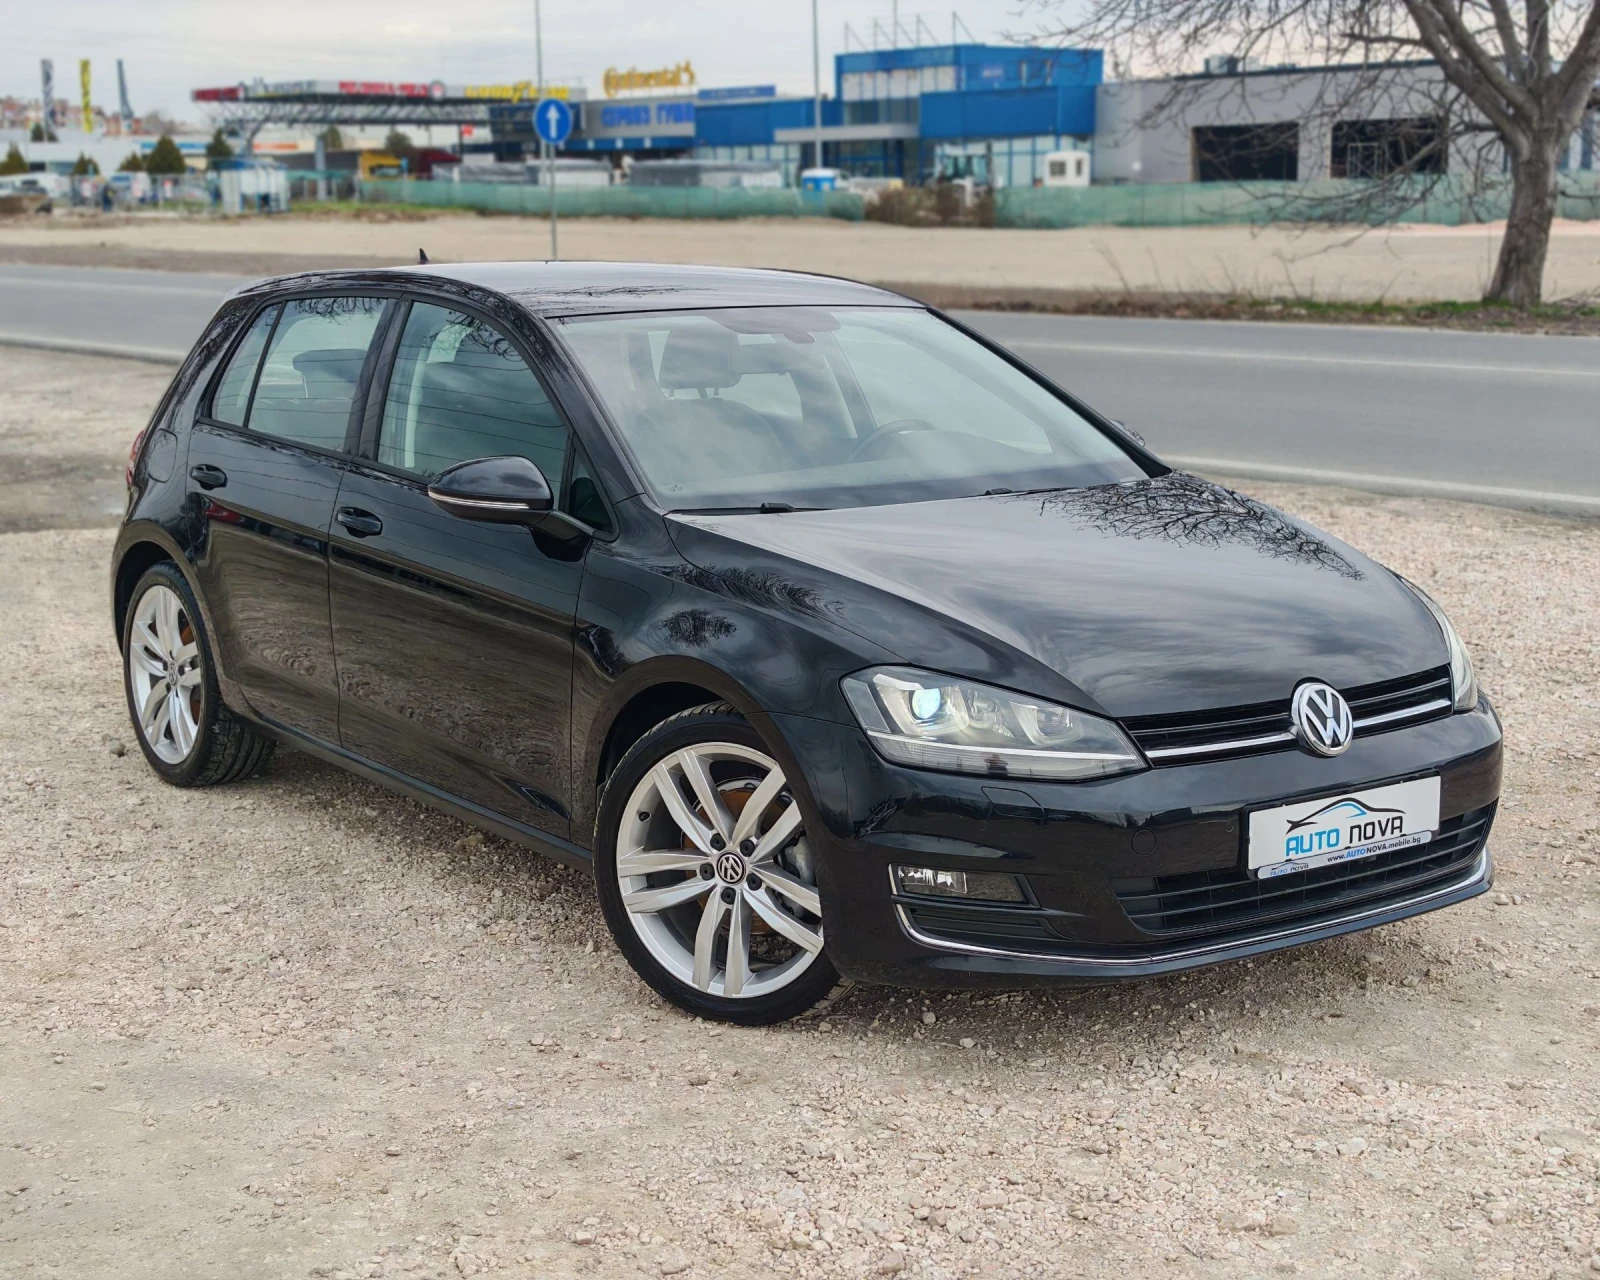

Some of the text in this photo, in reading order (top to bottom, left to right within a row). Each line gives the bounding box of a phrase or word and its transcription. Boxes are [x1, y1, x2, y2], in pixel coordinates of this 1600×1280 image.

[1297, 684, 1352, 754] VW
[1285, 815, 1404, 857] AUTO NOVA
[1269, 868, 1288, 877] AUTO
